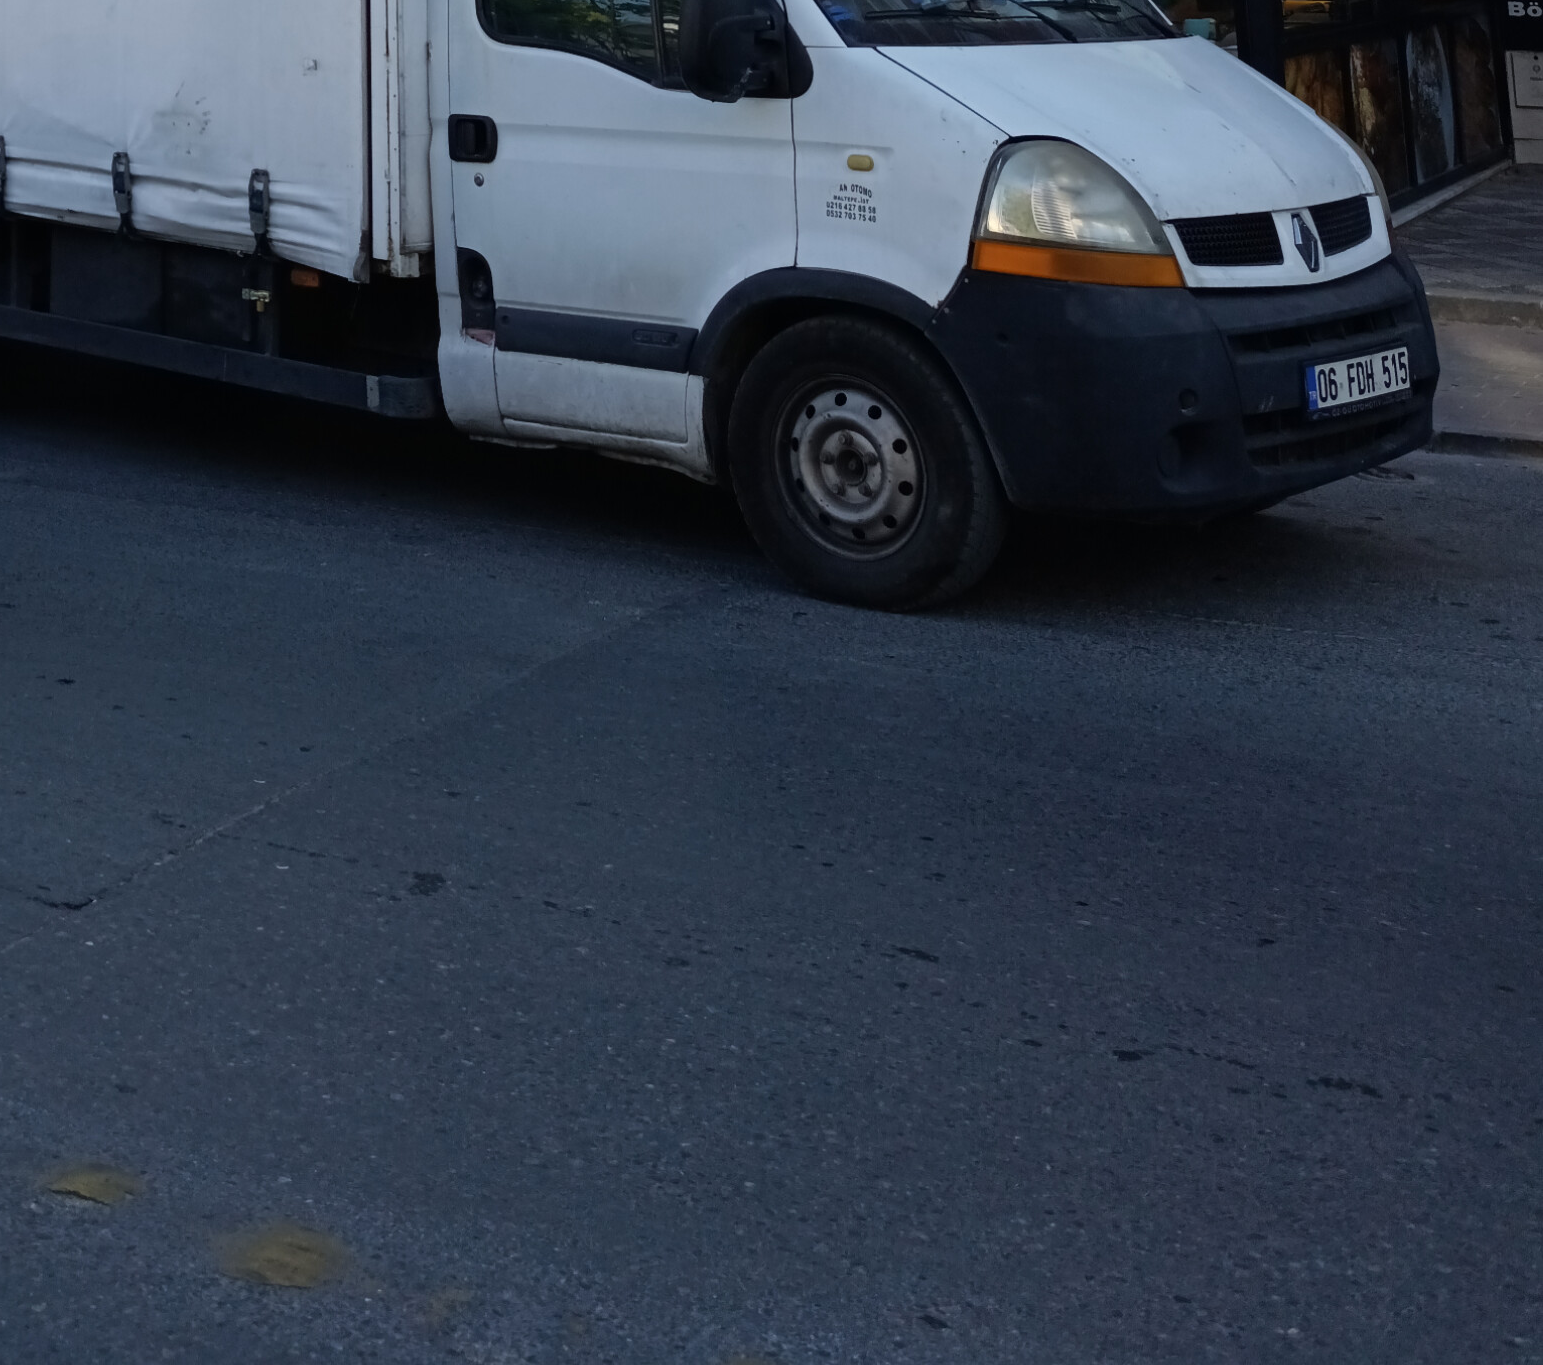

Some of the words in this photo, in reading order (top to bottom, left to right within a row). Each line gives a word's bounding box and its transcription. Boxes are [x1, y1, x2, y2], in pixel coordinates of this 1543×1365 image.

[1318, 367, 1338, 402] 06
[1346, 359, 1375, 397] FDH
[1381, 352, 1408, 388] 515
